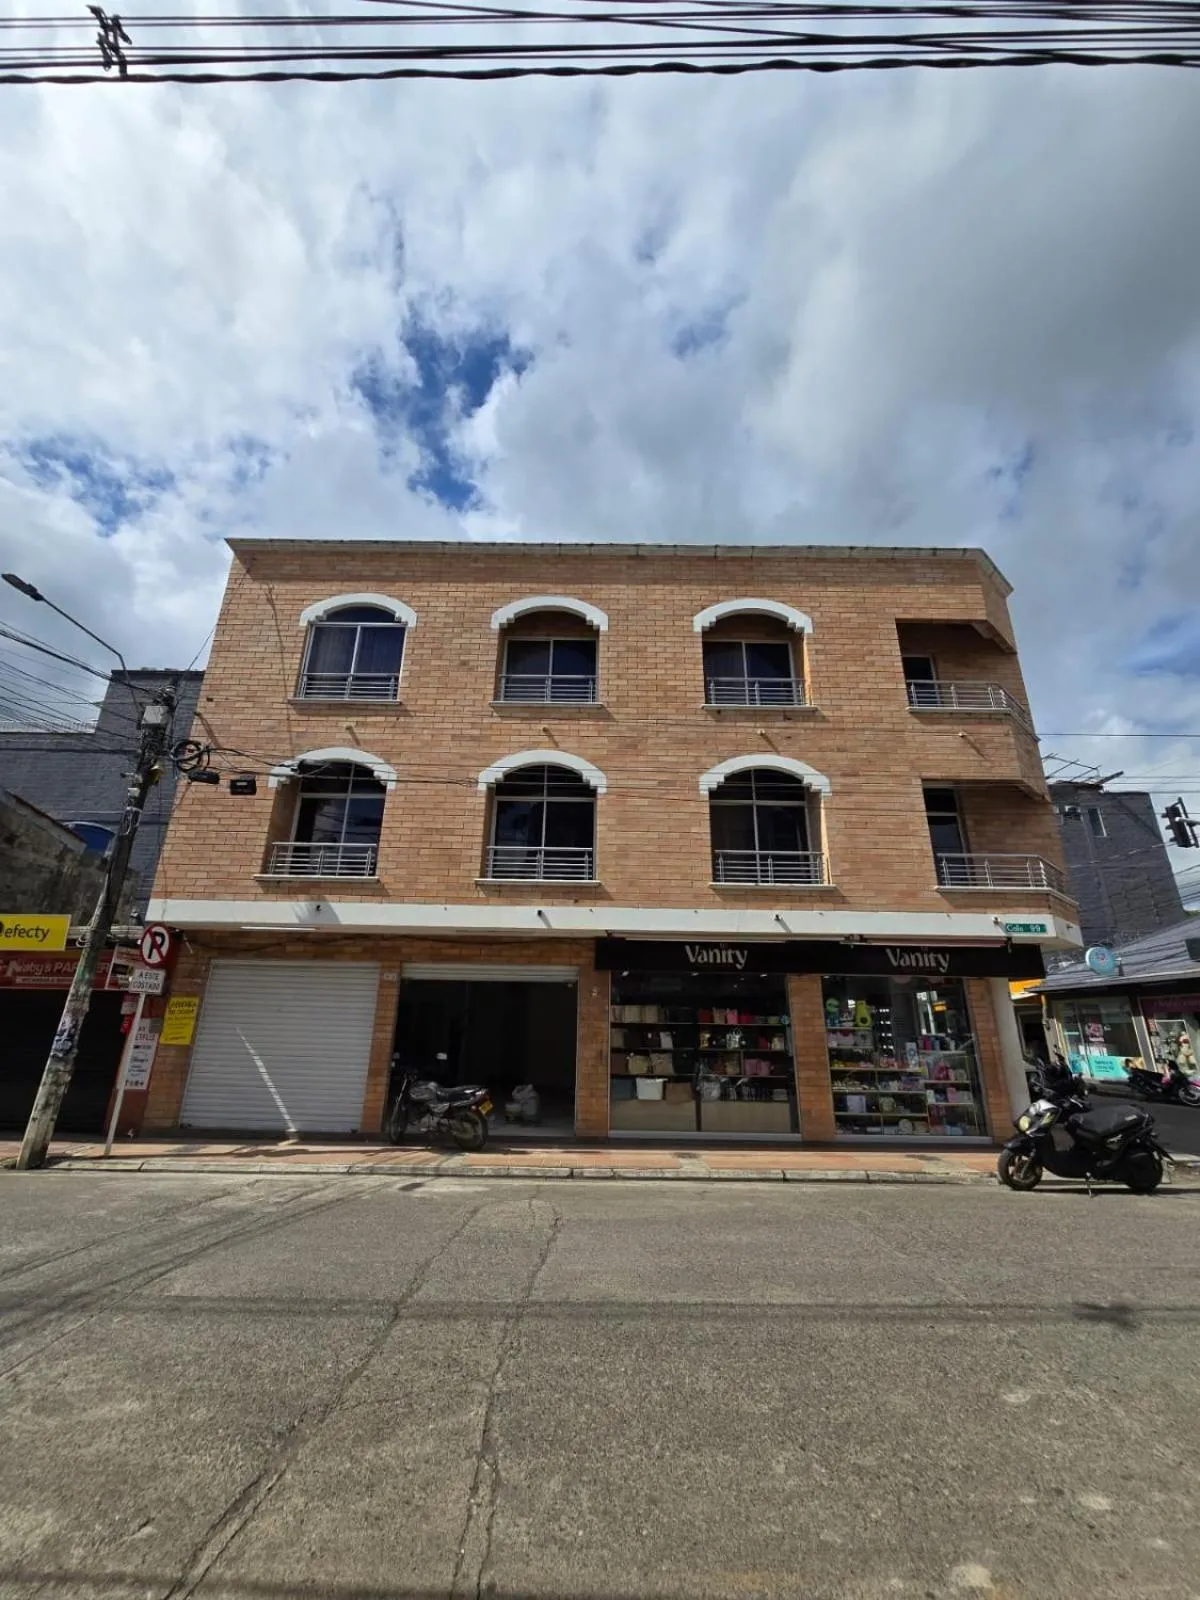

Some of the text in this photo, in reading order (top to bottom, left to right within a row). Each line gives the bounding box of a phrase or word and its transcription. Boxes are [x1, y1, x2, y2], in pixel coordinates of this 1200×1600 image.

[4, 923, 50, 943] efecty
[684, 944, 748, 969] Vanity
[886, 948, 950, 973] Vanity
[138, 971, 161, 981] A ESTE
